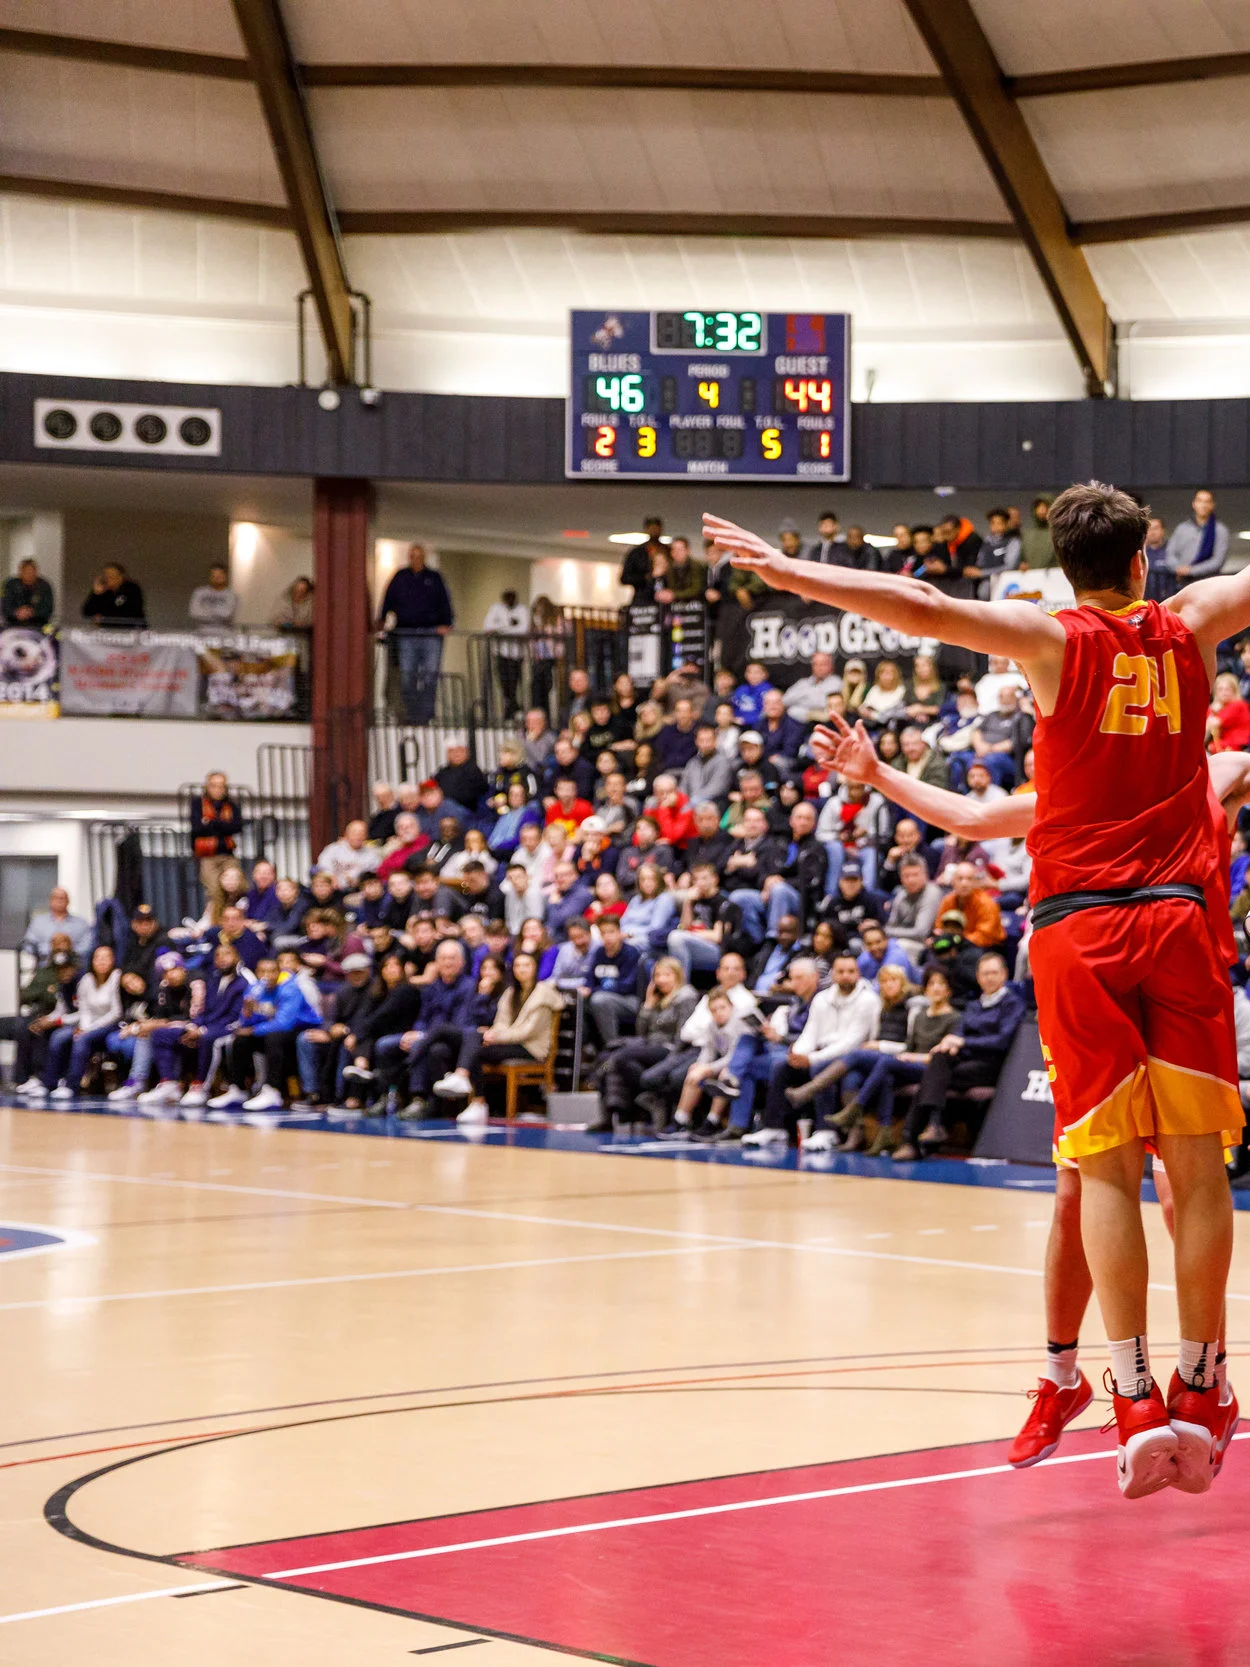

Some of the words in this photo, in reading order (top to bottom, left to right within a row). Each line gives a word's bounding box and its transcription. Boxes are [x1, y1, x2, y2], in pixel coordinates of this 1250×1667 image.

[683, 311, 762, 351] 7:32
[588, 353, 642, 373] BLUES
[687, 363, 731, 378] PERIOD
[775, 355, 830, 375] GUEST
[596, 374, 645, 412] 46
[698, 381, 719, 409] 4
[784, 378, 832, 414] 44
[581, 412, 619, 427] FOULS
[669, 414, 714, 429] PLAYER
[716, 414, 747, 430] FOUL
[797, 415, 836, 431] FOULS
[594, 424, 617, 458] 2
[637, 425, 657, 458] 3
[761, 427, 782, 460] 5
[820, 430, 831, 459] 1
[1099, 648, 1182, 736] 24
